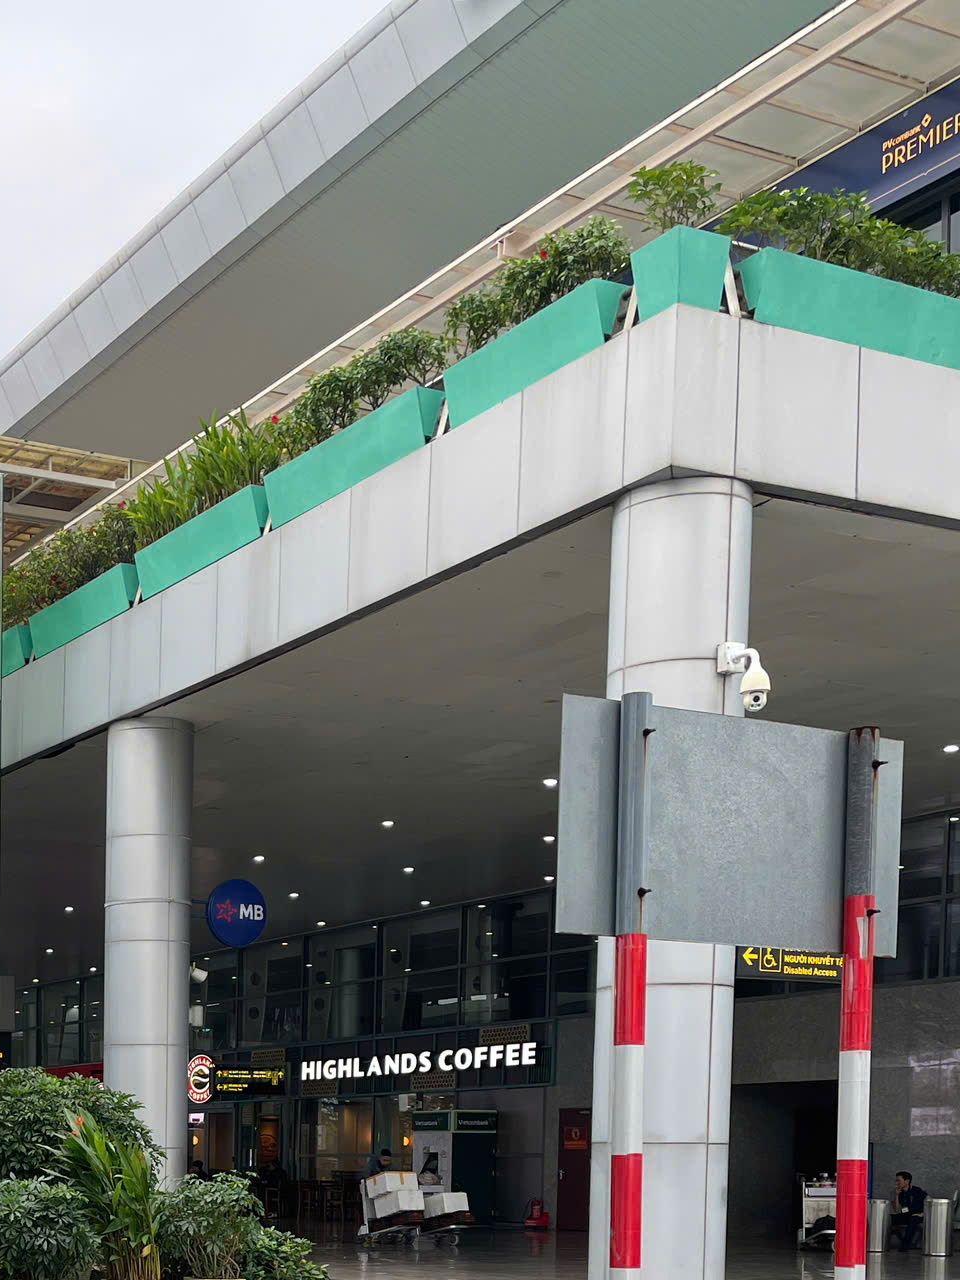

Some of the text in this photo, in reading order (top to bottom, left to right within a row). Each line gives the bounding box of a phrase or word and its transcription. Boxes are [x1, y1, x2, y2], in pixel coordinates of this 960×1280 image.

[239, 904, 264, 920] MB
[784, 966, 837, 976] Disabled Access
[301, 1042, 537, 1081] HIGHLANDS COFFEE
